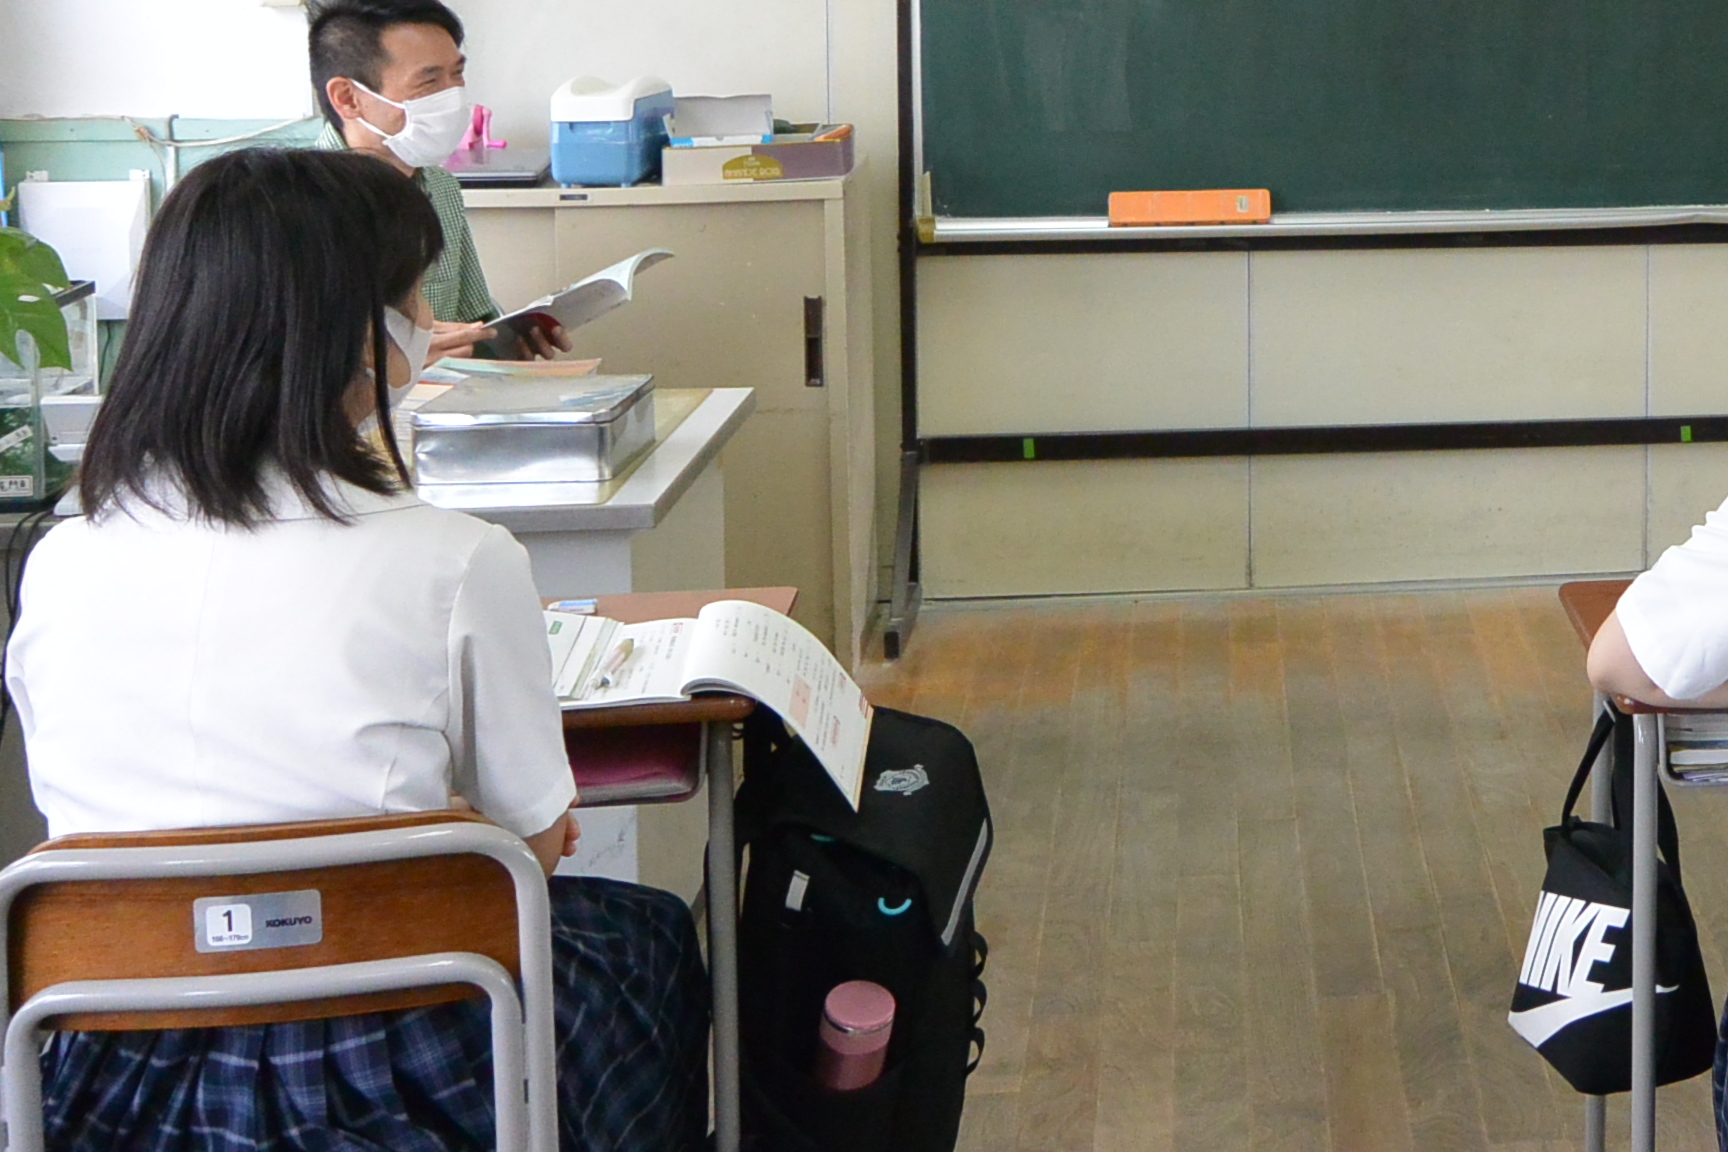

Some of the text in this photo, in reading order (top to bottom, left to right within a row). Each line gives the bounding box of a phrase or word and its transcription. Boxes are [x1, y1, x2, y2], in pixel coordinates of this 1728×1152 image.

[222, 909, 233, 932] 1
[265, 915, 313, 928] KOKUYO
[1518, 890, 1631, 998] NIKE
